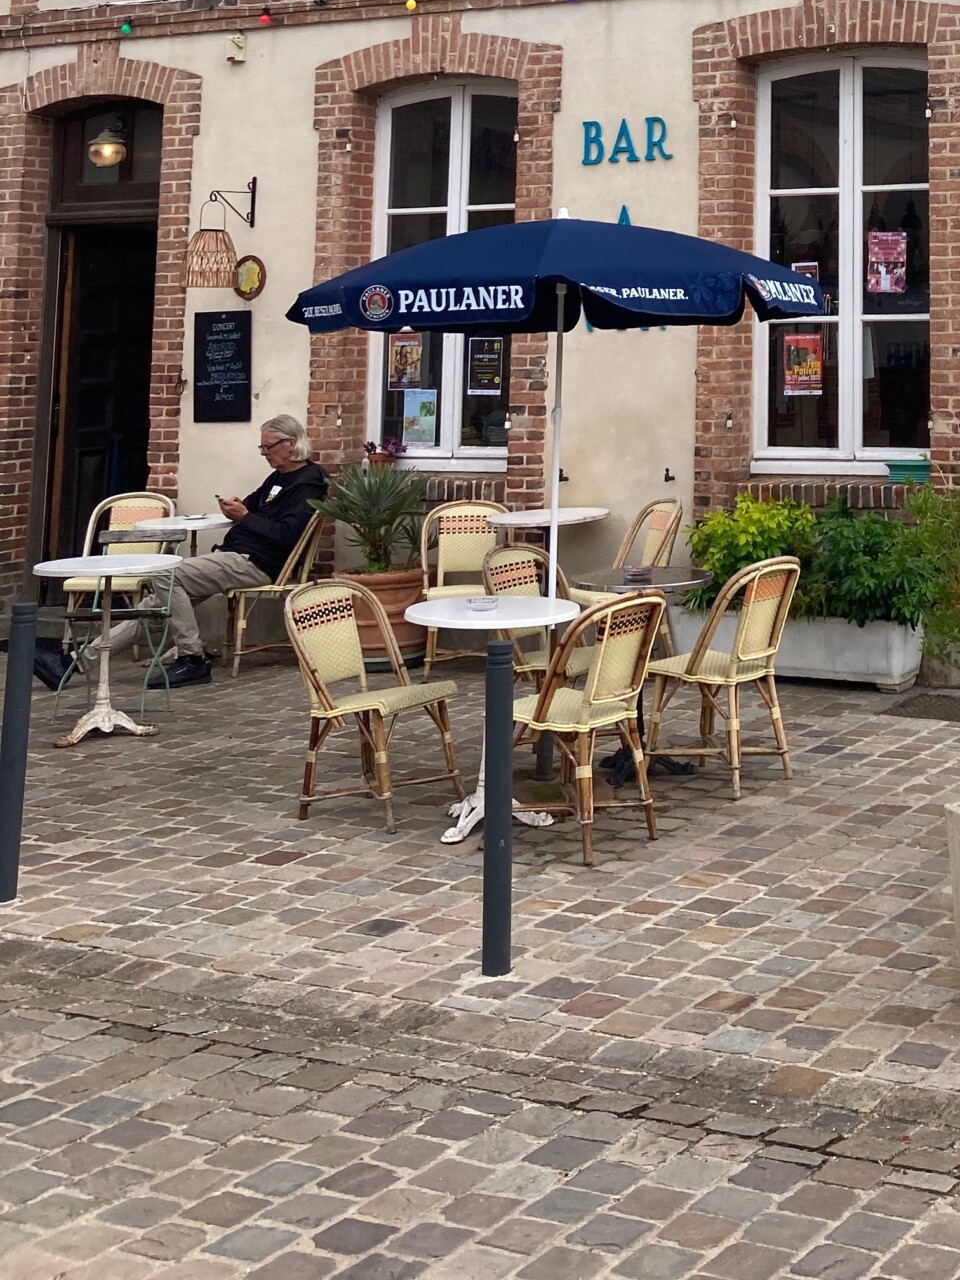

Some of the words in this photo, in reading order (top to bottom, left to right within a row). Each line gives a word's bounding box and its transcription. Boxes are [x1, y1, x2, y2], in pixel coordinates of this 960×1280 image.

[582, 117, 673, 166] BAR
[362, 287, 391, 301] PAULANER
[398, 285, 525, 313] PAULANER
[622, 287, 689, 300] PAULANER.
